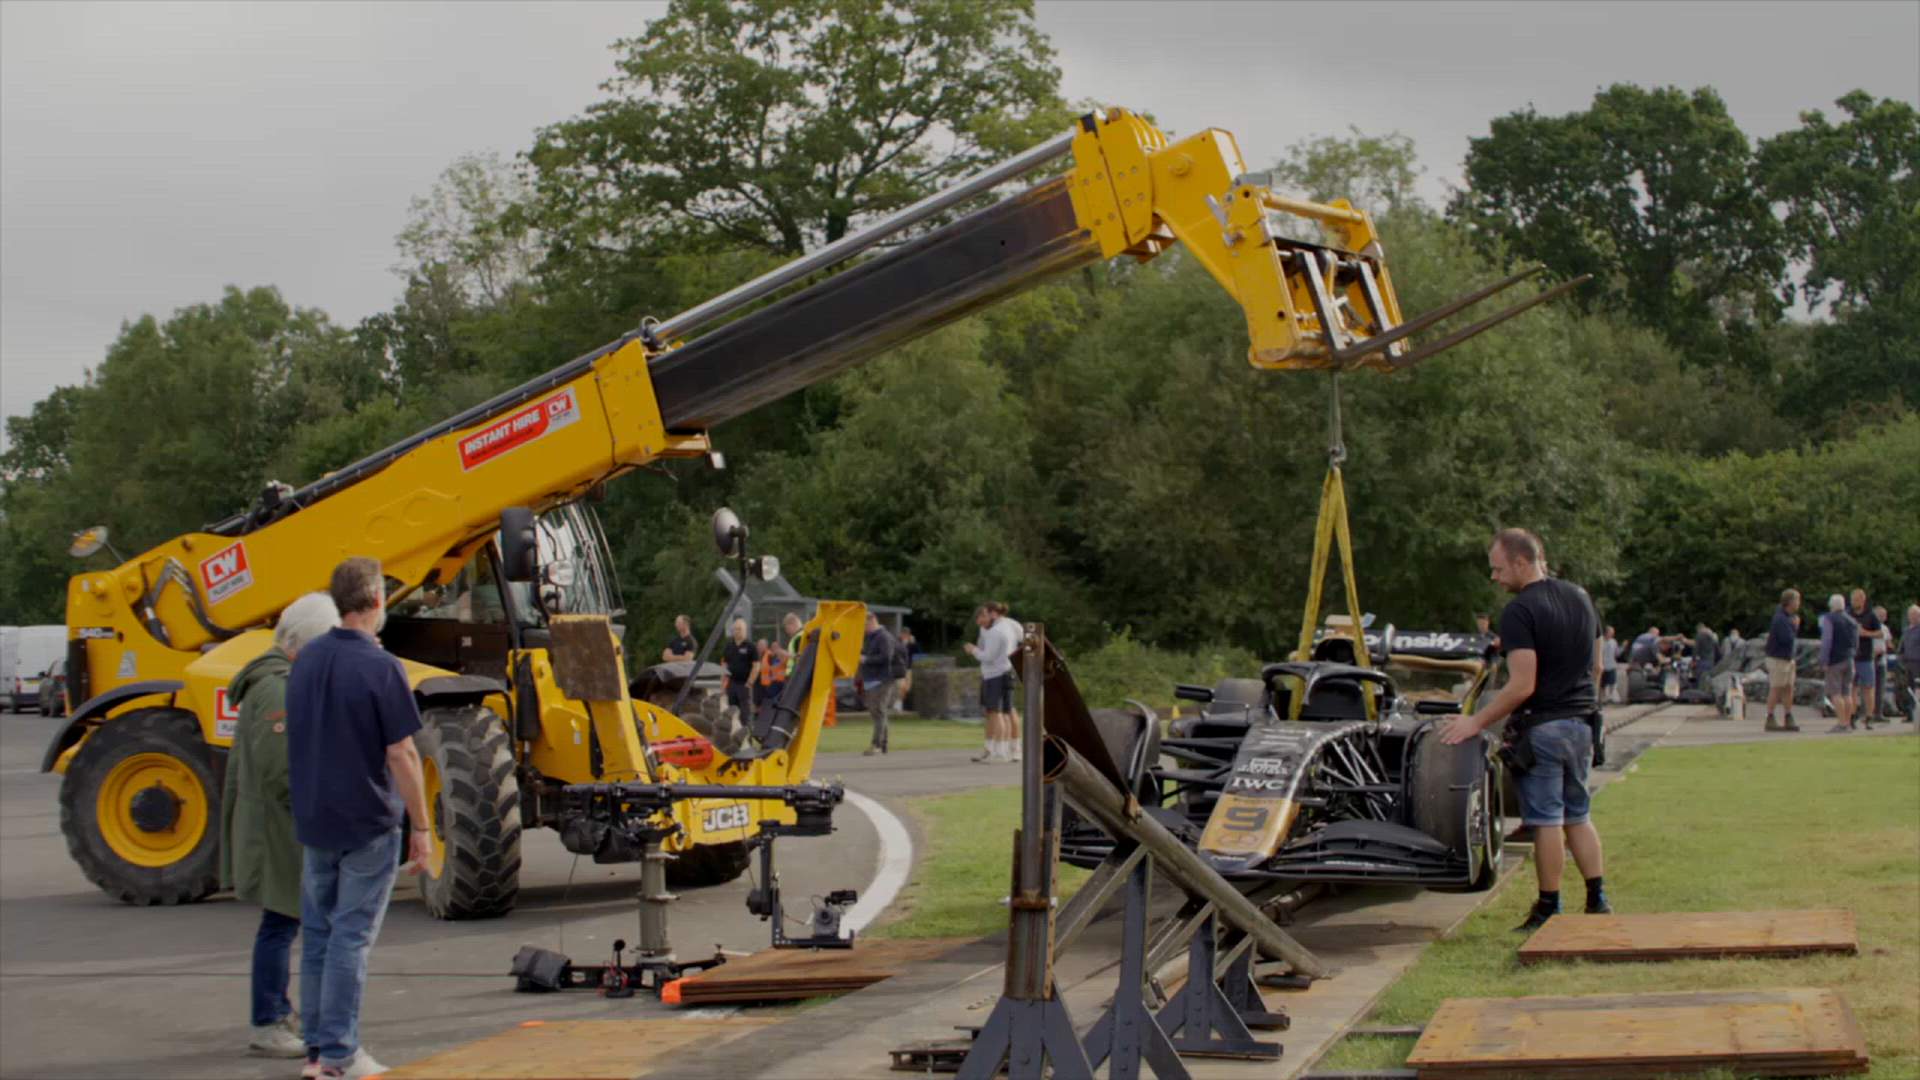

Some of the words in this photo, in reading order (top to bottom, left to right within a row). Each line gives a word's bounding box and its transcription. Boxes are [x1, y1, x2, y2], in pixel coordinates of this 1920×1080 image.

[548, 396, 569, 416] CW
[464, 422, 511, 455] INSTANT
[512, 408, 541, 433] HIRE
[207, 548, 238, 583] CW
[1231, 777, 1287, 790] IWC
[703, 803, 749, 833] JCB
[1223, 807, 1270, 832] 9
